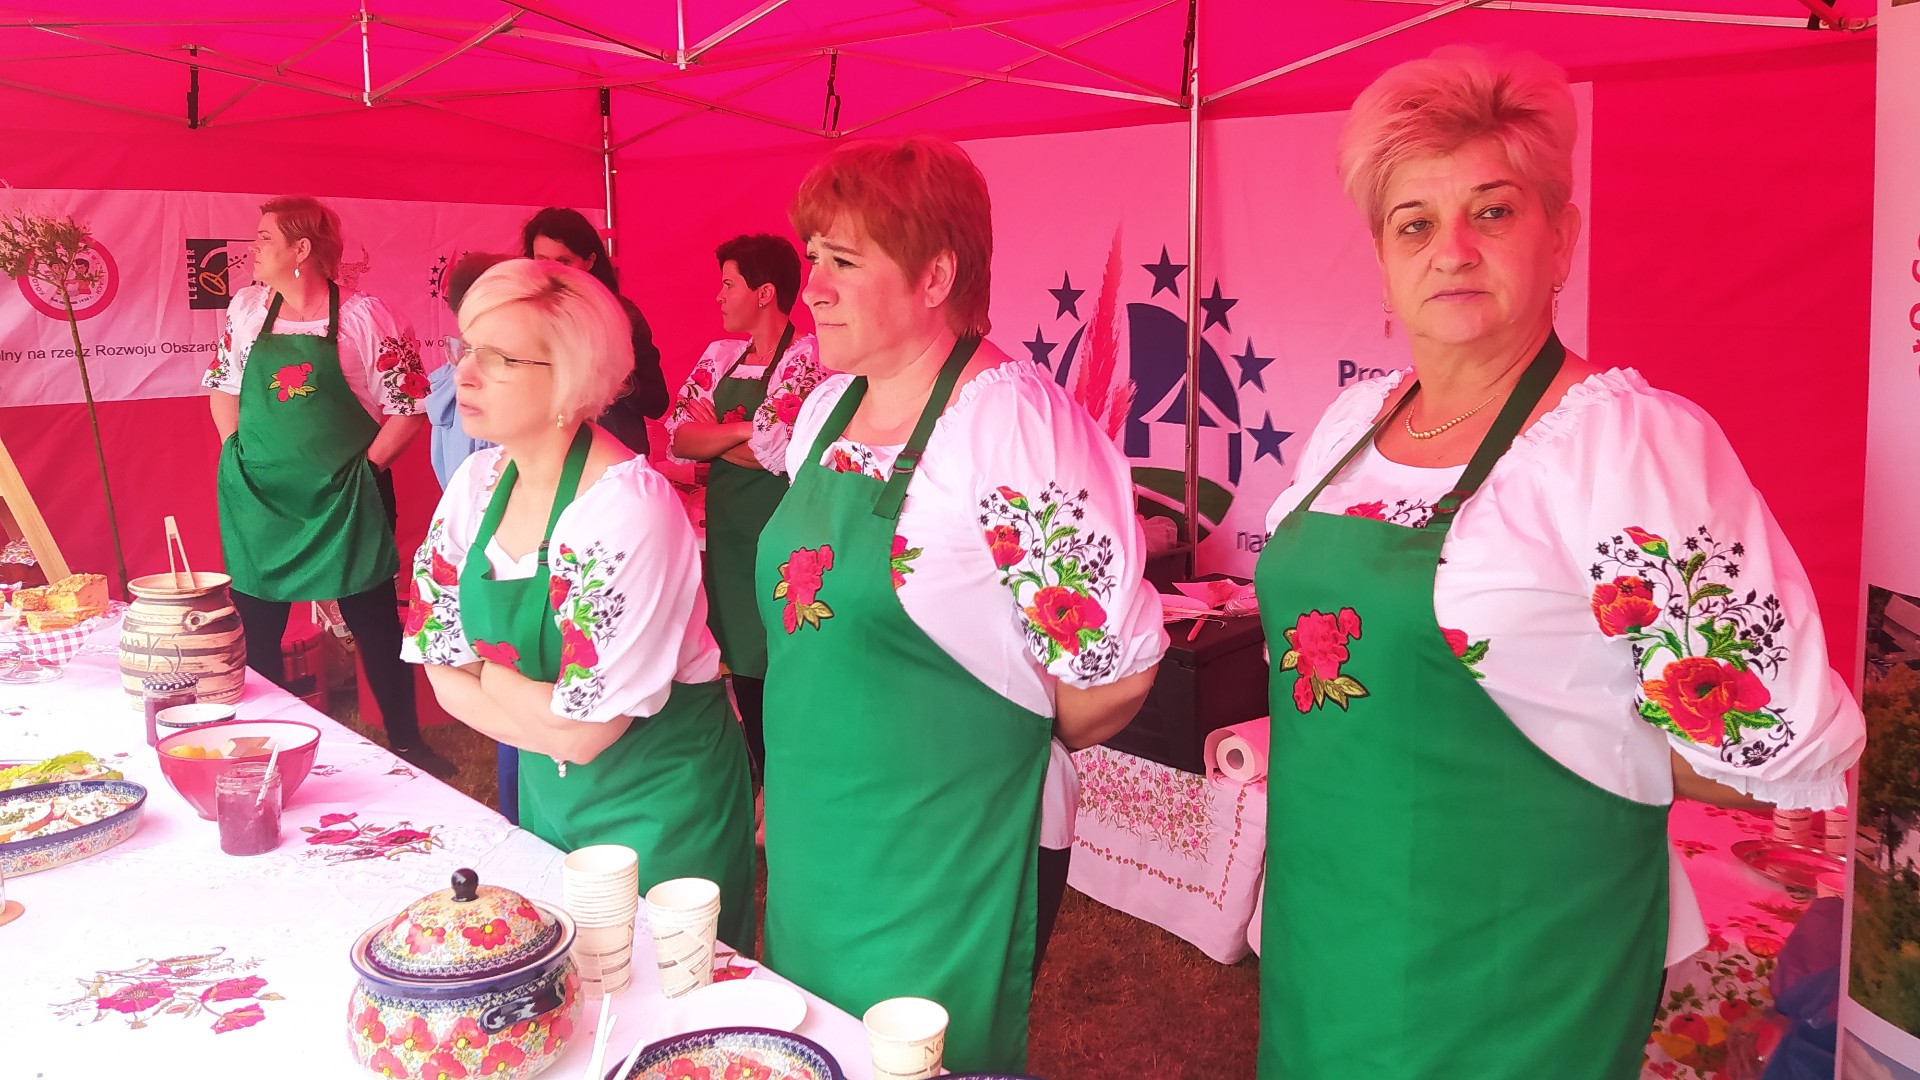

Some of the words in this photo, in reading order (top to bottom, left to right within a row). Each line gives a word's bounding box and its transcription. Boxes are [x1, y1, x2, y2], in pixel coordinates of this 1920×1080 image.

[186, 249, 198, 300] LEADER
[0, 350, 22, 363] lny
[28, 350, 45, 359] na
[96, 343, 156, 357] Rozwoju
[161, 341, 218, 354] Obszaró
[1338, 360, 1403, 387] Pro
